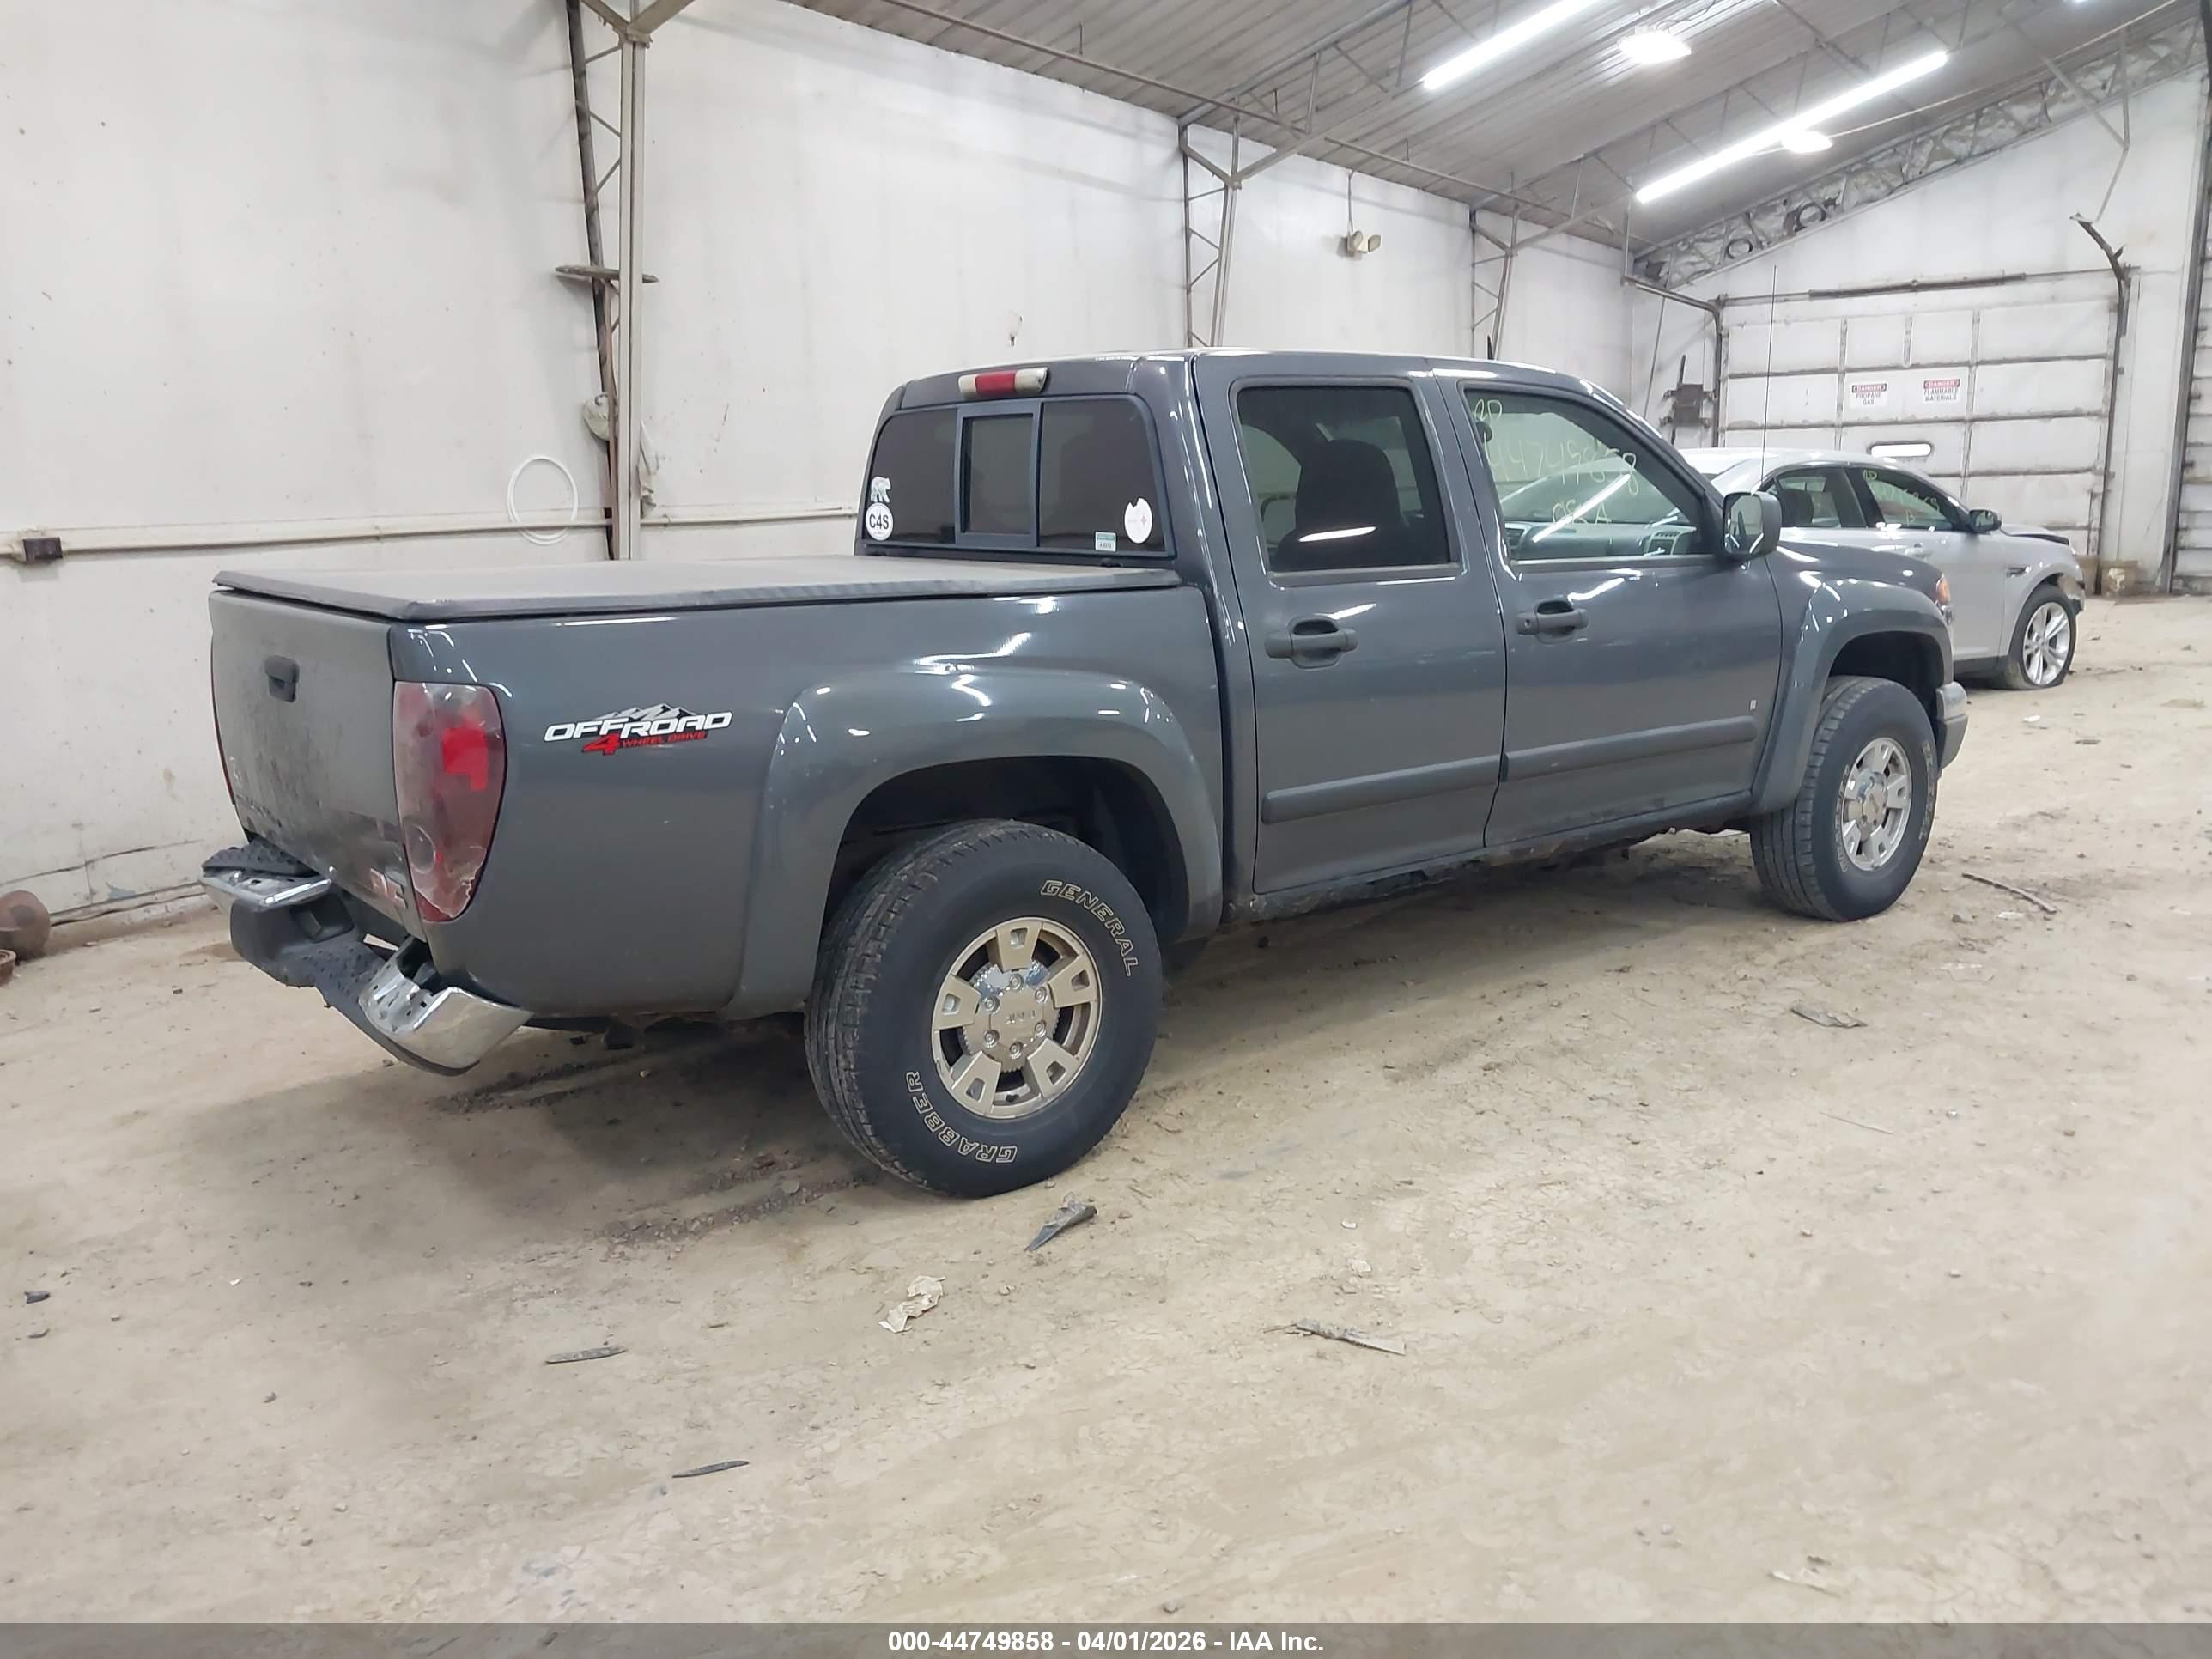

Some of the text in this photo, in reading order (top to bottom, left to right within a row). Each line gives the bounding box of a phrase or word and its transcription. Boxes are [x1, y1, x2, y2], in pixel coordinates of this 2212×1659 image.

[1856, 384, 1882, 392] DANGER
[869, 514, 890, 530] C4S
[544, 711, 732, 742] OFFROAD
[582, 730, 707, 756] 4 WHEEL DRIVE
[1040, 879, 1139, 977] GENERAL
[906, 1071, 1018, 1164] GRABBER
